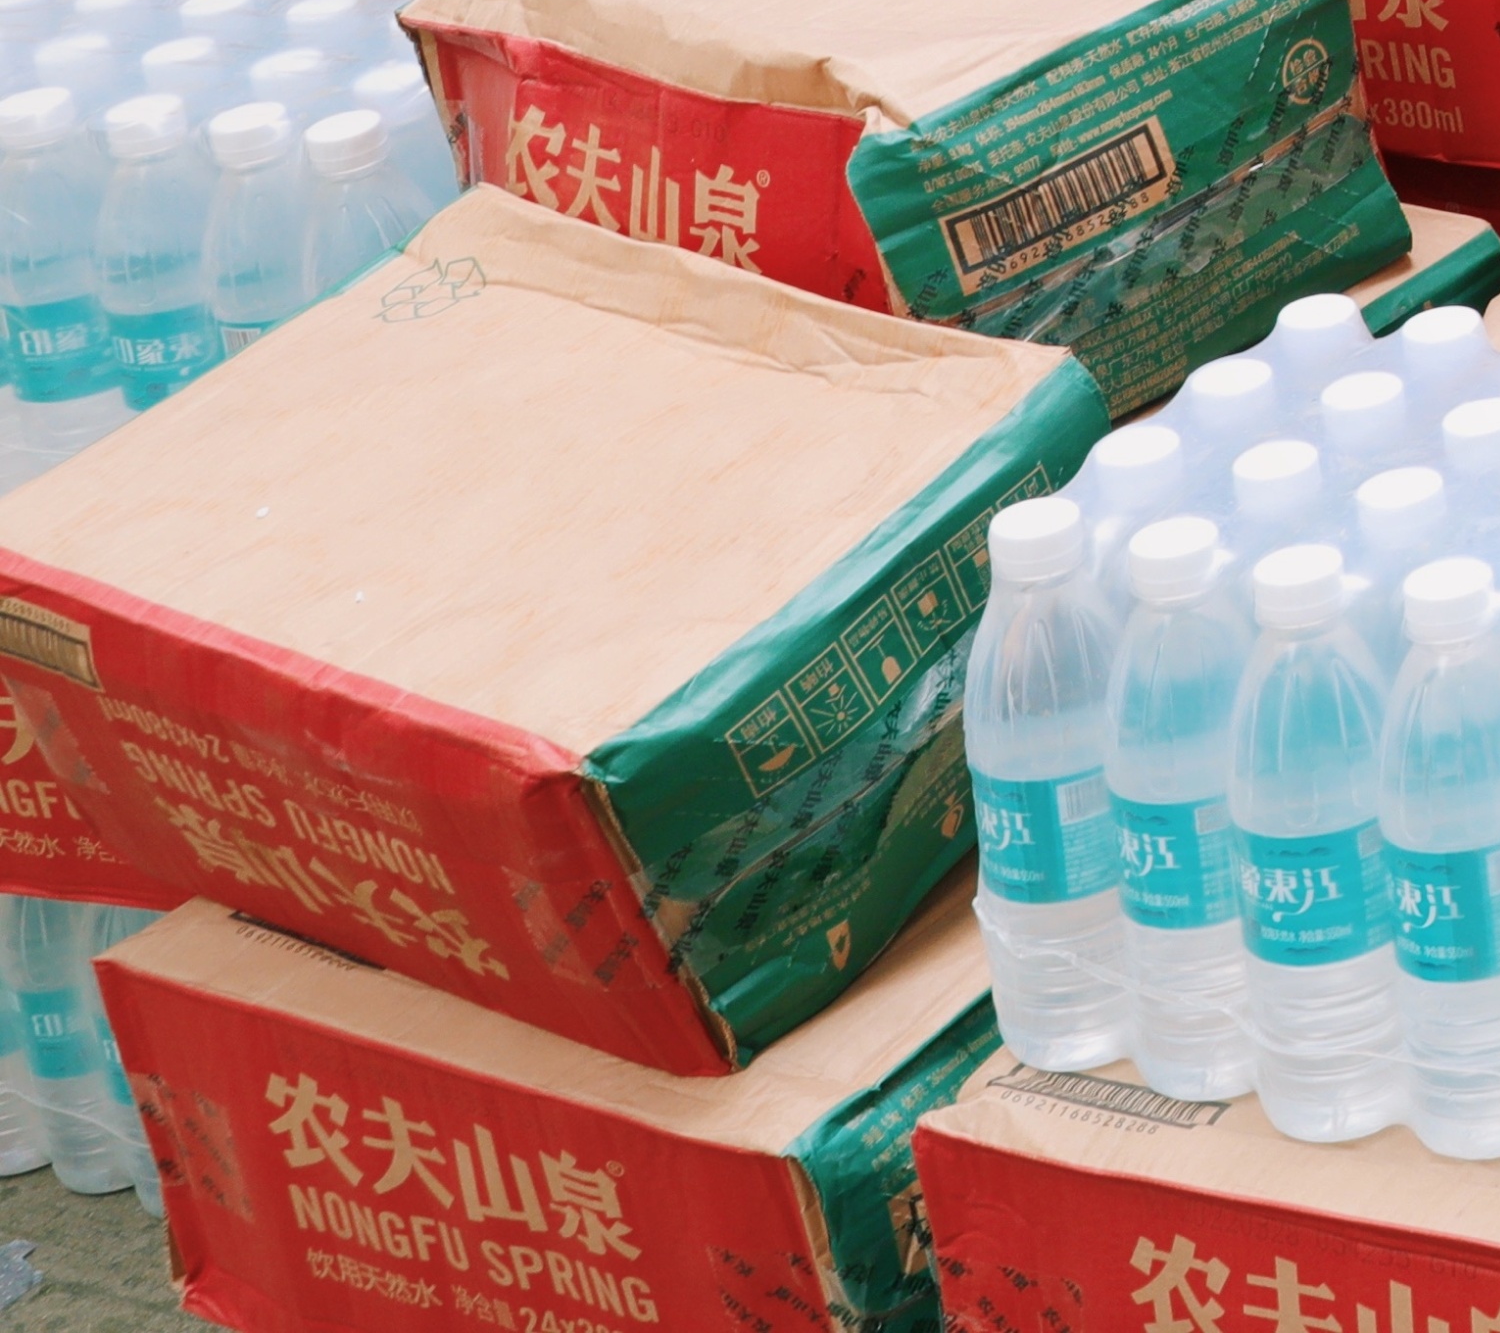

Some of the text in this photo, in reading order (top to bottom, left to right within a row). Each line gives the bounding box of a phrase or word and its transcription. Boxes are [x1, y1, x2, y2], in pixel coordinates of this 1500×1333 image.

[505, 104, 763, 275] 农夫山泉
[119, 738, 455, 895] NONGFU SPRING
[151, 796, 511, 981] 农夫山泉
[263, 1072, 643, 1264] 农夫山泉
[288, 1185, 661, 1326] NONGFU SPRING
[304, 1246, 444, 1311] 饮用天然水
